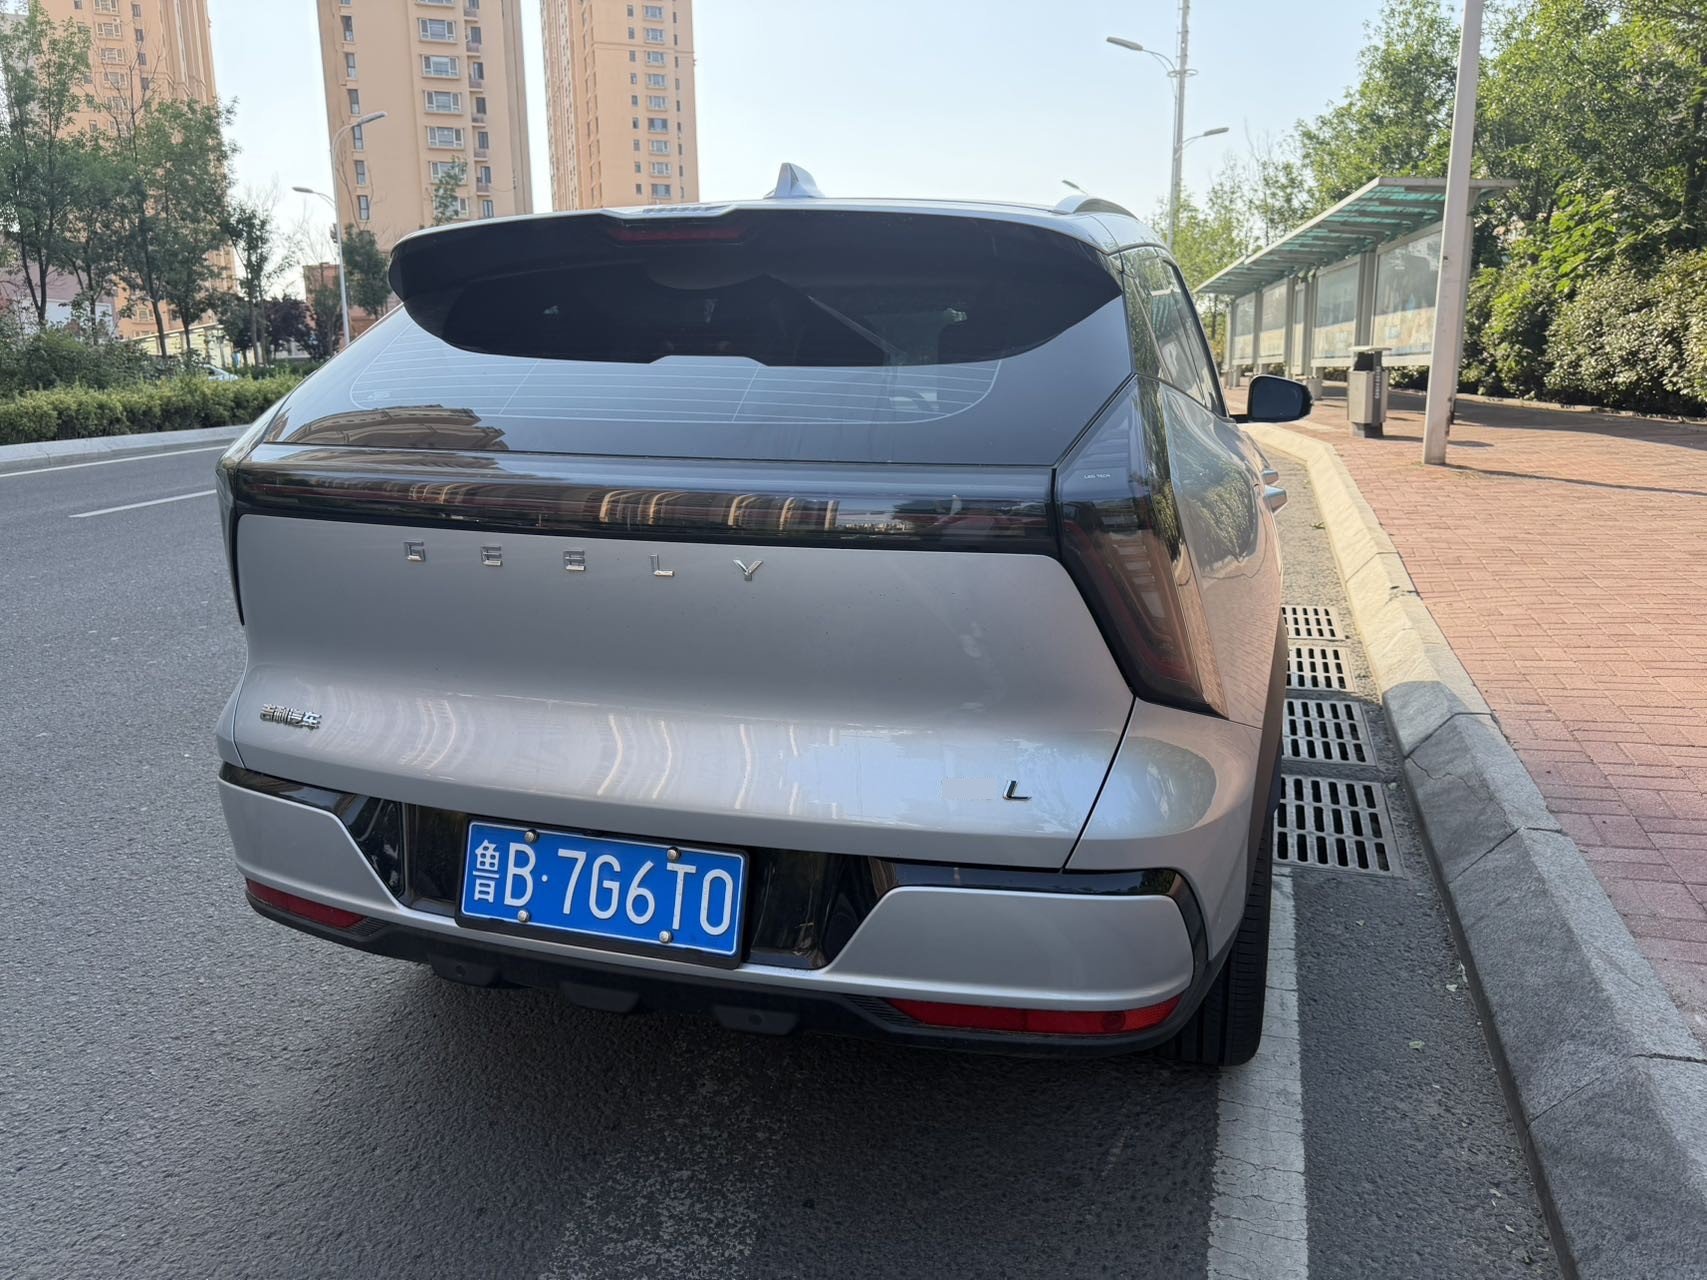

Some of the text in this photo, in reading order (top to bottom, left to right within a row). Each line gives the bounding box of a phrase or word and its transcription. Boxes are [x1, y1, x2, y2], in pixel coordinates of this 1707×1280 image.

[404, 539, 764, 582] GEELY
[260, 703, 322, 730] 吉利汽车
[1003, 780, 1032, 800] L
